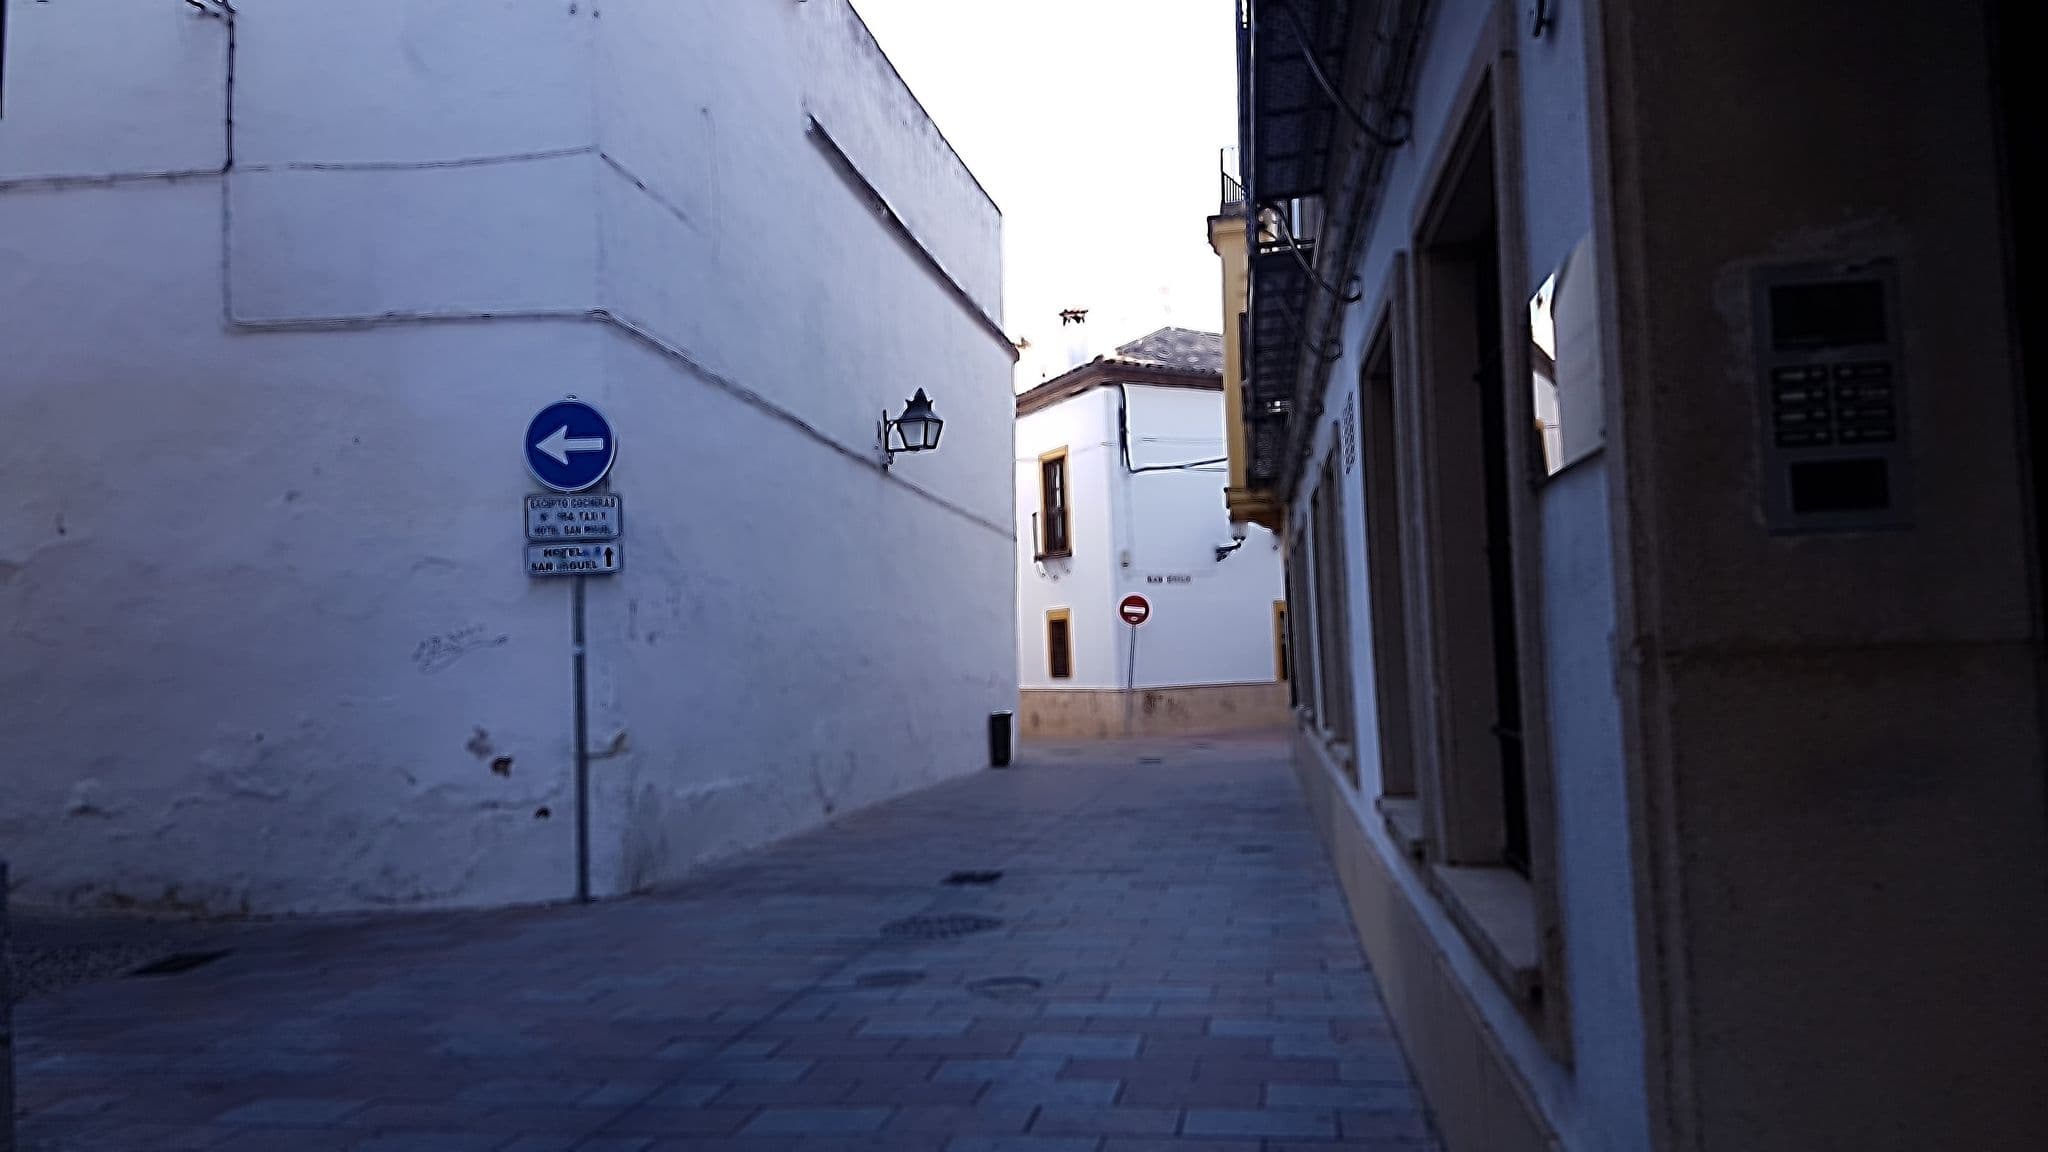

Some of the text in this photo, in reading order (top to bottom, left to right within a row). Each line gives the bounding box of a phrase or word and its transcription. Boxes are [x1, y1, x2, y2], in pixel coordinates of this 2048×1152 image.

[530, 496, 616, 509] EXCEPTO COCHERAS
[564, 525, 582, 535] SAN
[543, 547, 585, 558] HOTEL
[531, 561, 553, 571] SAN
